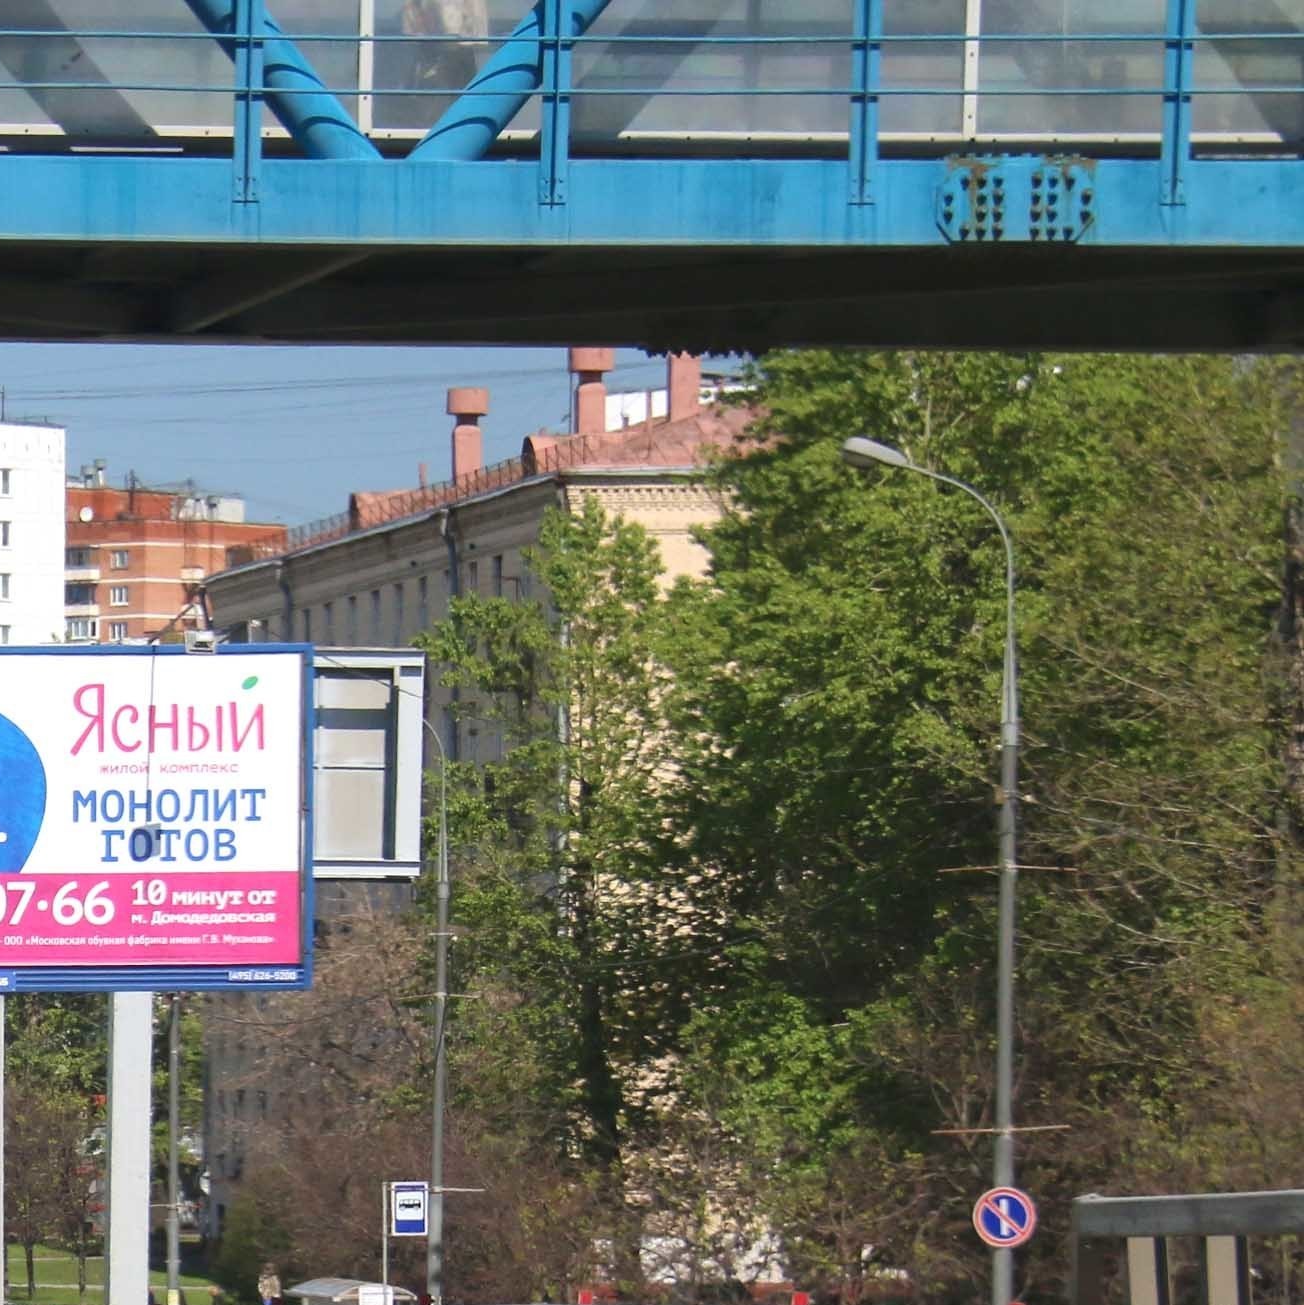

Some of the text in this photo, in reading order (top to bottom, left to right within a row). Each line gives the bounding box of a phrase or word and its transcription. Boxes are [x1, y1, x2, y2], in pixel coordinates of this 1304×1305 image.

[70, 676, 265, 756] Ясный
[98, 761, 239, 775] жилой комплекс
[130, 879, 277, 910] 10 минут от
[150, 910, 277, 926] Домодедовская
